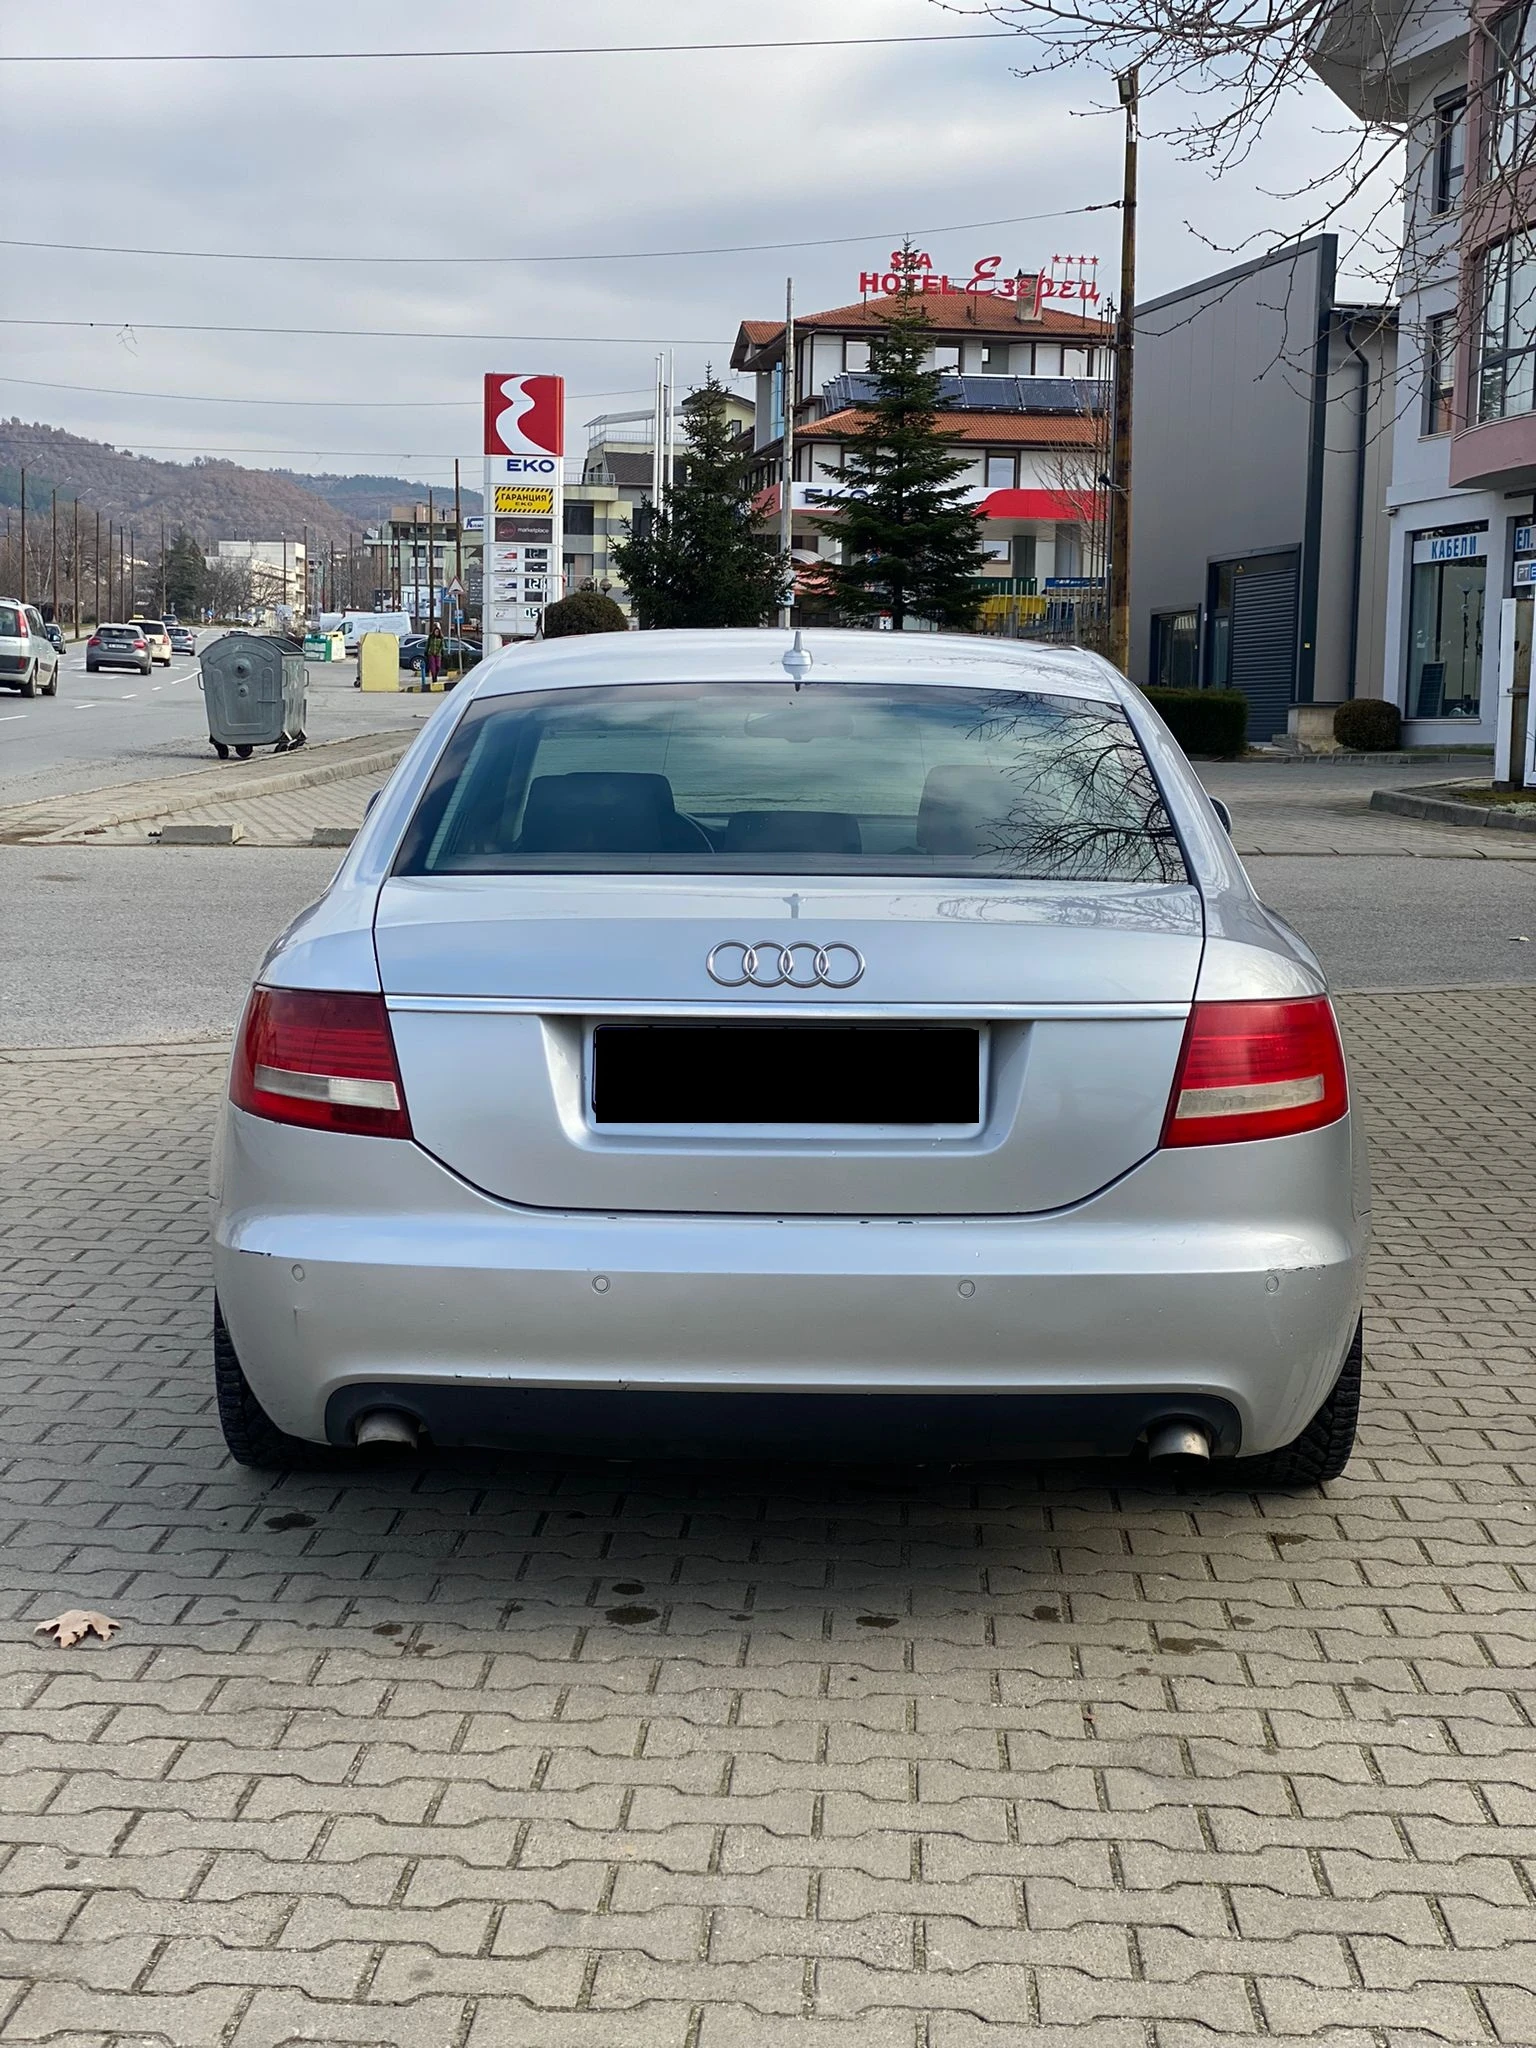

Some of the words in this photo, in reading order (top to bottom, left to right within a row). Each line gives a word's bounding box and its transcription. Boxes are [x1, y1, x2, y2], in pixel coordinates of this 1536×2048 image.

[890, 250, 934, 270] SPA
[859, 271, 958, 297] HOTEL
[506, 458, 555, 473] EKO
[500, 493, 547, 502] ГАРАНЦИЯ
[1431, 535, 1478, 560] КАБЕЛИ
